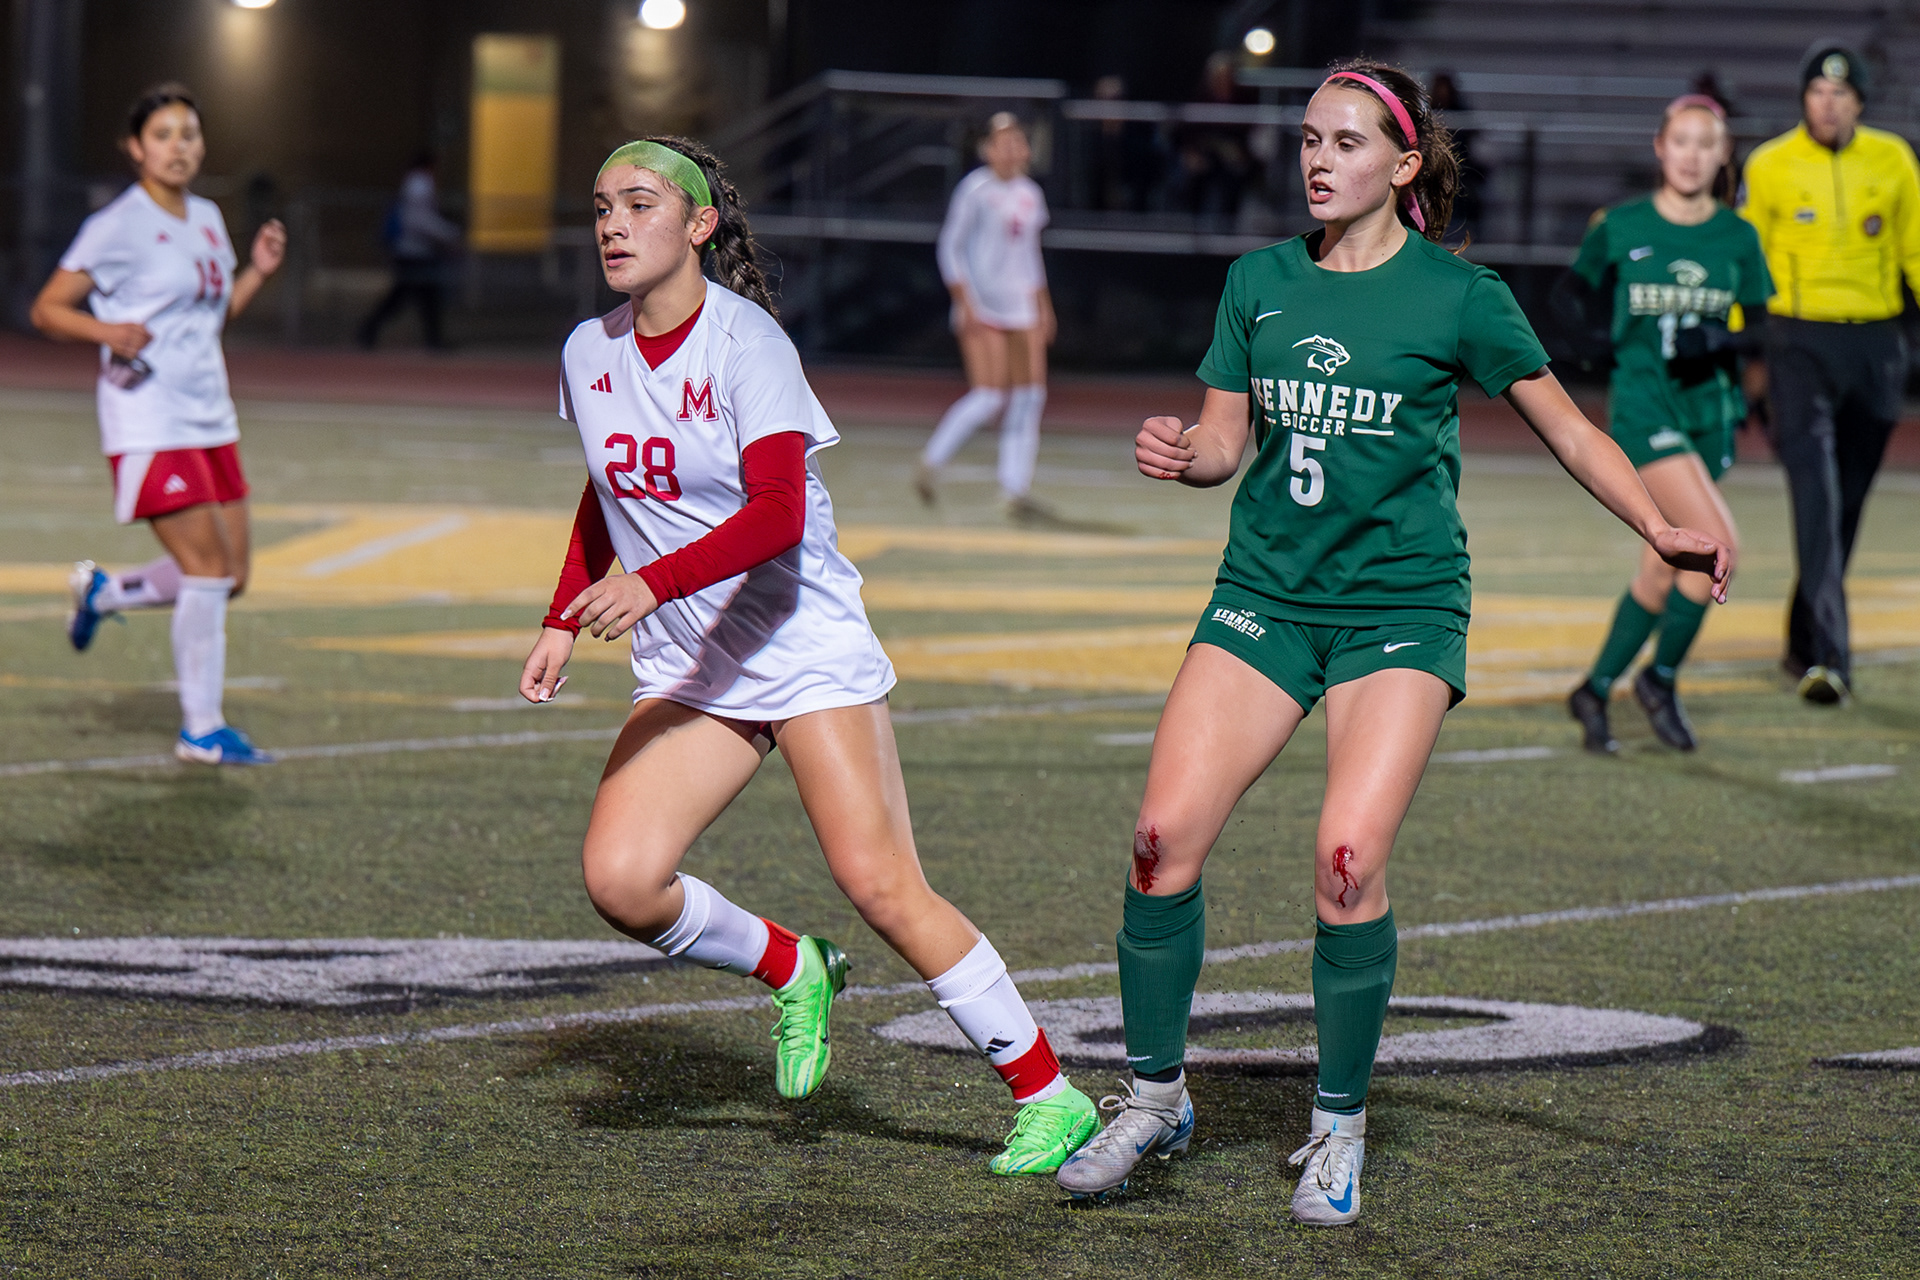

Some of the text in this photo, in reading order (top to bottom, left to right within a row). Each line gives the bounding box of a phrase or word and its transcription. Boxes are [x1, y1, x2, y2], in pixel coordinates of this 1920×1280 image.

[676, 377, 719, 422] M
[1281, 412, 1345, 436] SOCCER
[604, 433, 682, 501] 28
[1290, 433, 1326, 507] 5
[1212, 608, 1266, 638] KENNEDY
